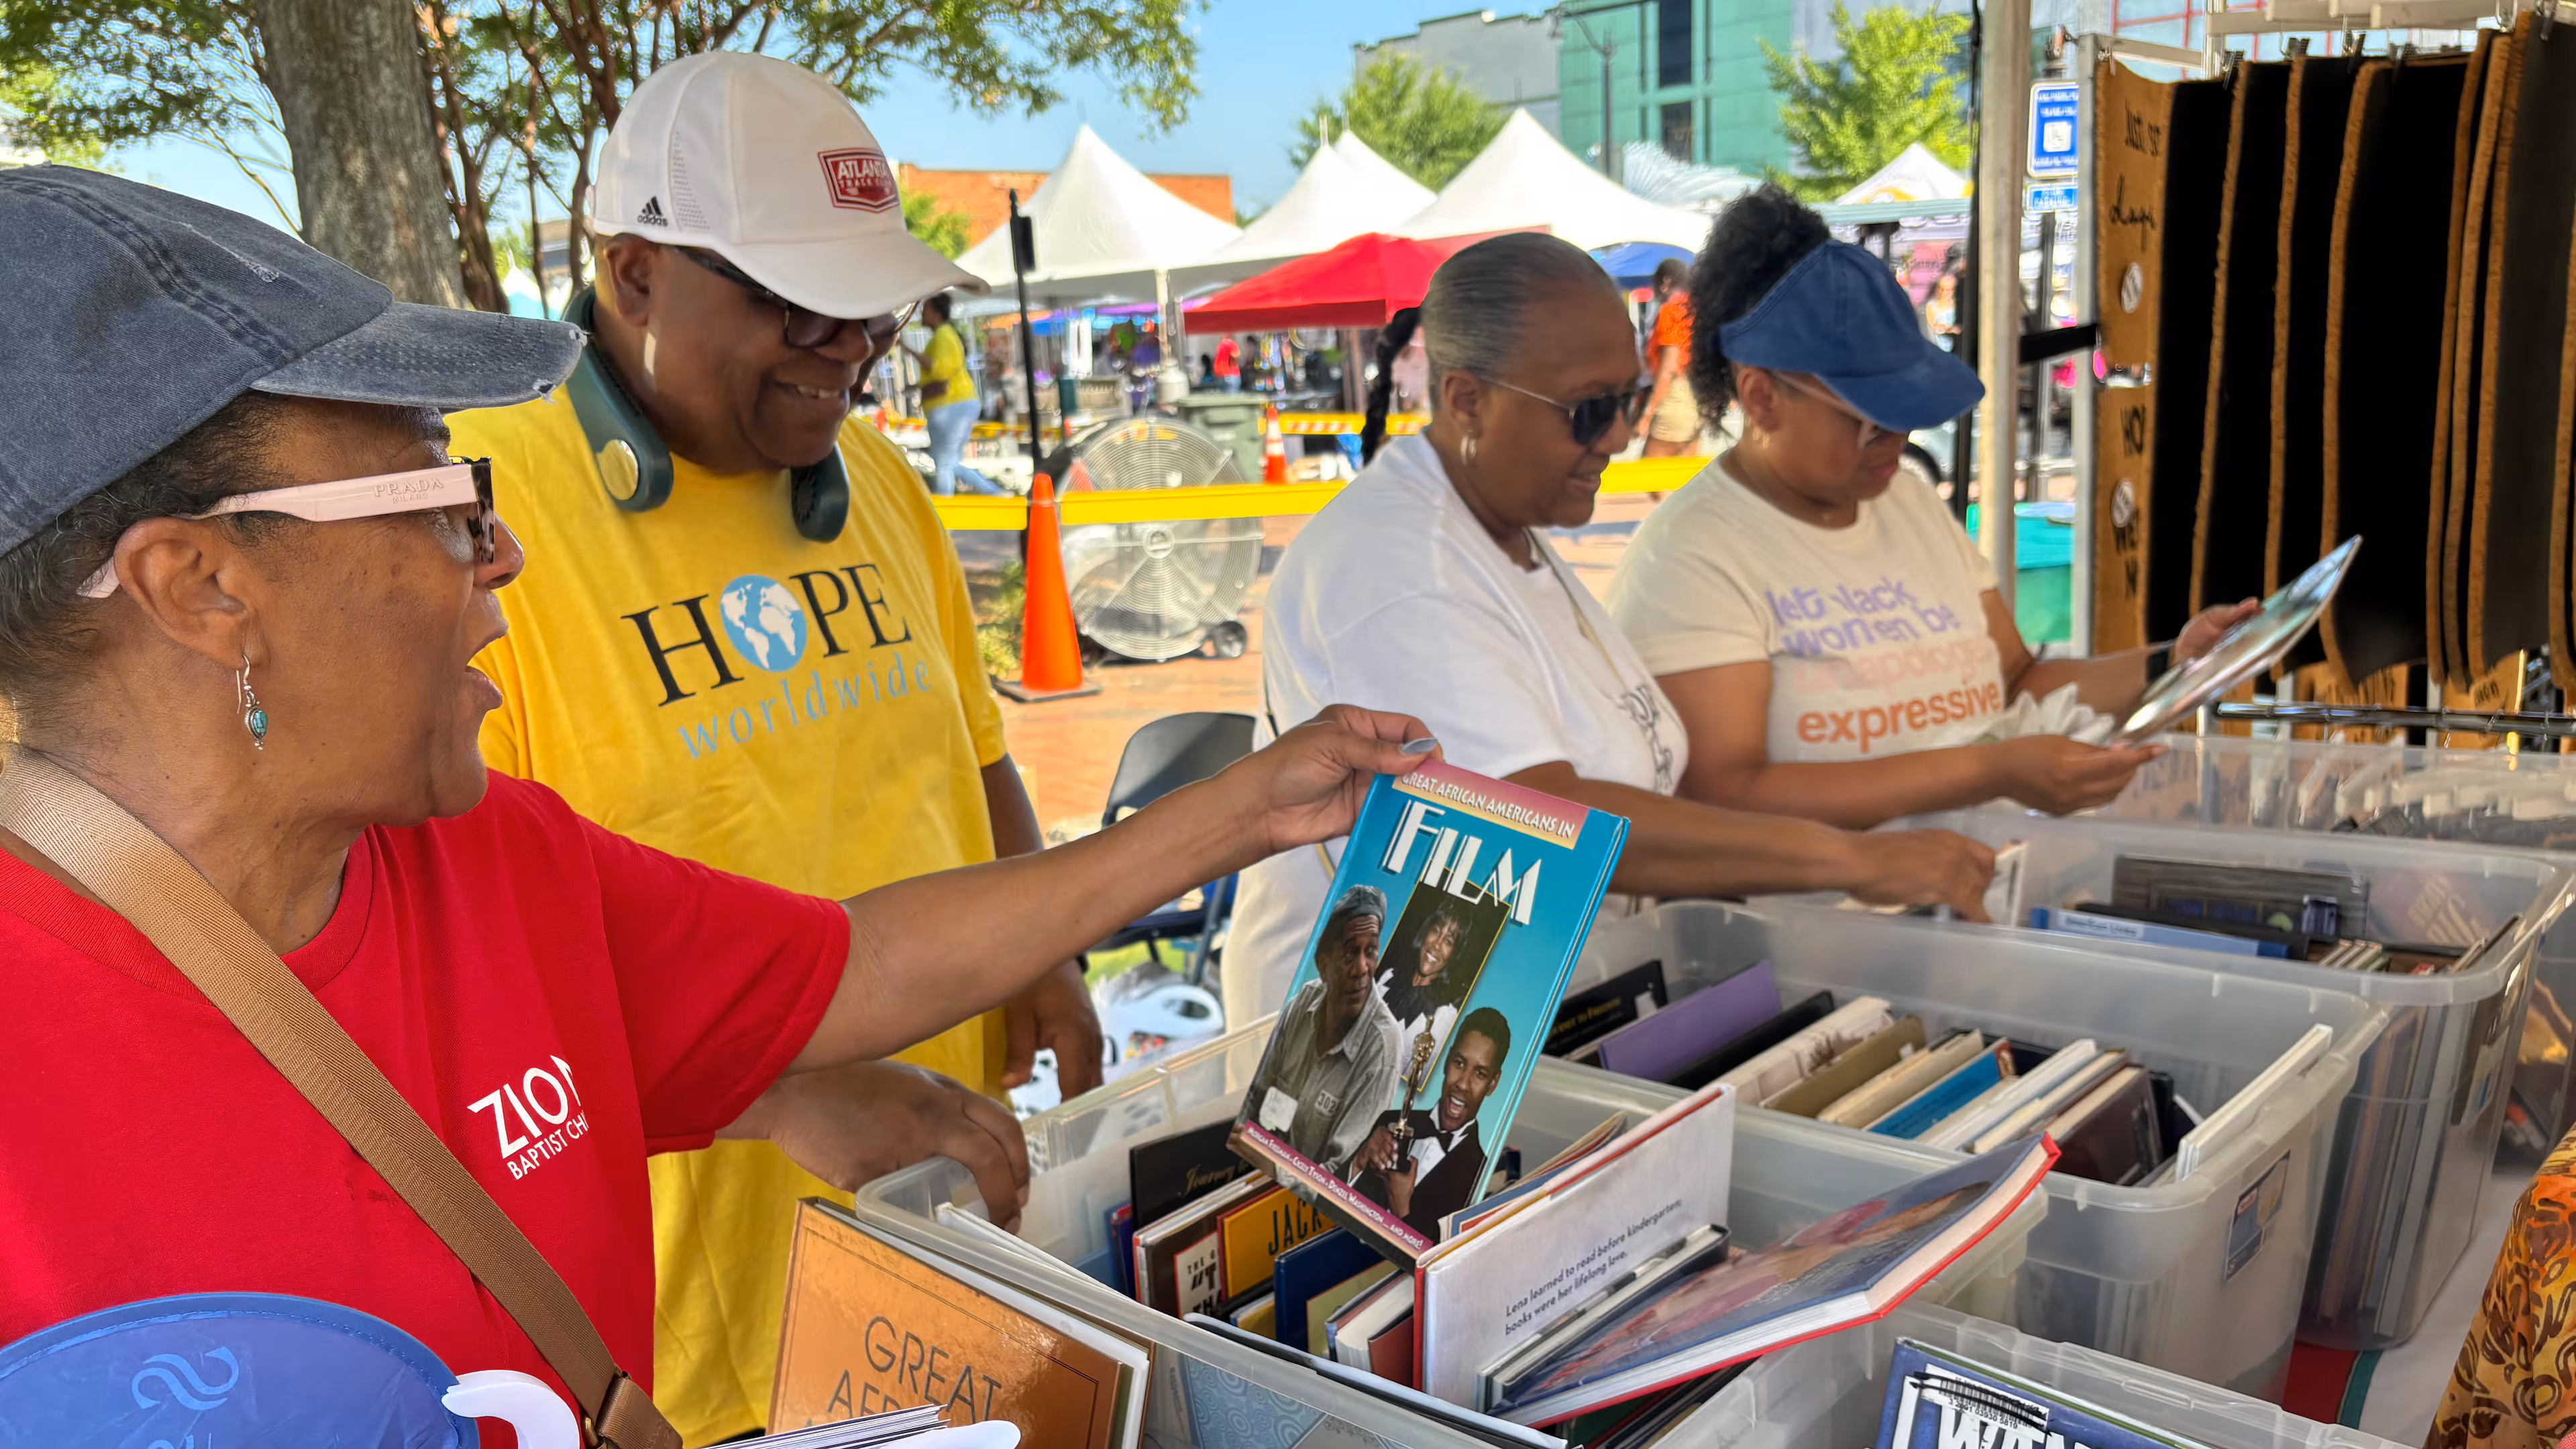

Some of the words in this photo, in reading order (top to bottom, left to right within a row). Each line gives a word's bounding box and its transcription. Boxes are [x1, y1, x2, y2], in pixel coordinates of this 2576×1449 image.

[637, 214, 668, 227] adidas
[374, 477, 444, 497] PRADA
[392, 492, 428, 504] MILANO
[678, 652, 932, 759] worldwide
[1797, 676, 2002, 754] expressive
[1402, 772, 1438, 792] GREAT
[1437, 783, 1487, 810] AFRICAN
[1486, 798, 1556, 833] AMERICANS
[1556, 820, 1575, 839] IN
[1381, 799, 1542, 926] FILM
[1318, 1092, 1337, 1114] 302
[507, 1129, 568, 1180] BAPTIST
[566, 1110, 589, 1139] CH
[1505, 1313, 1532, 1336] books
[1534, 1297, 1556, 1316] were
[1558, 1284, 1573, 1301] her
[1574, 1263, 1607, 1290] lifelong
[1506, 1296, 1528, 1317] Lena
[1530, 1269, 1564, 1301] learned
[1565, 1267, 1575, 1279] to
[1576, 1249, 1597, 1272] read
[1597, 1233, 1625, 1258] before
[865, 1315, 1003, 1424] GREAT
